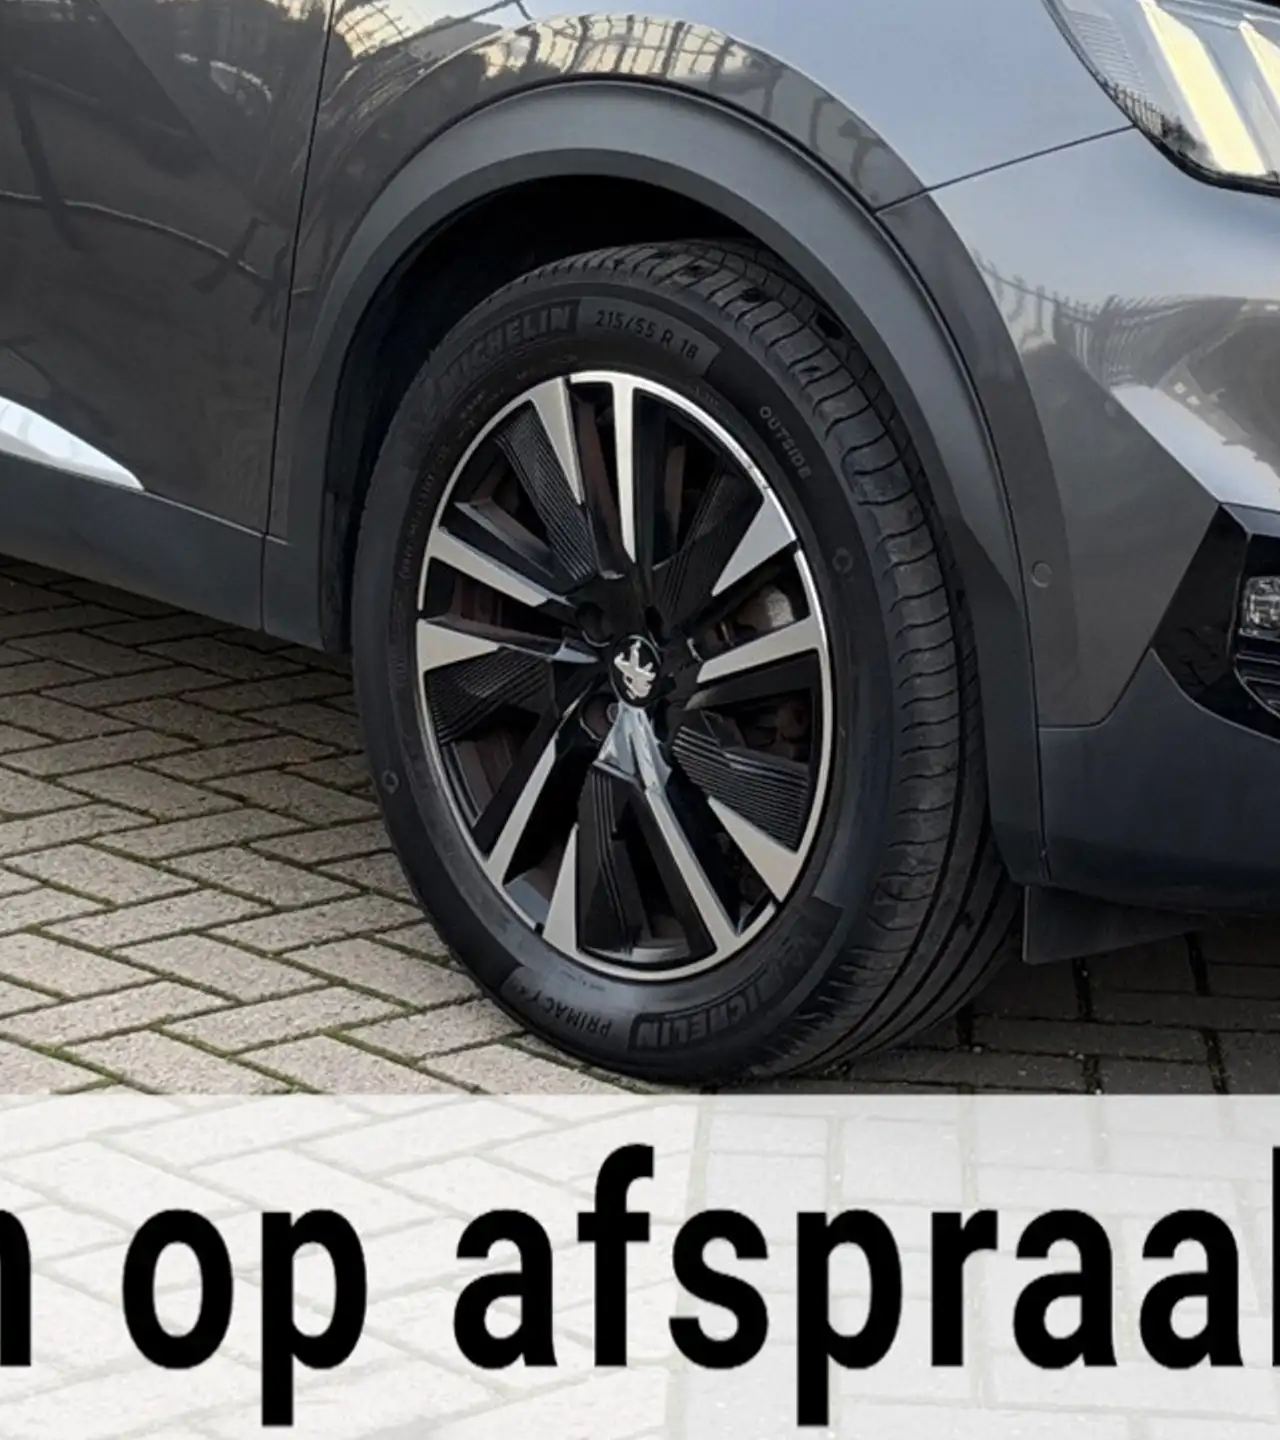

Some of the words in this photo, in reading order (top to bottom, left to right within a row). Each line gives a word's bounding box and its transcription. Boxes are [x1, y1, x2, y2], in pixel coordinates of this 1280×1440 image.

[595, 309, 658, 339] 215/55
[660, 328, 674, 347] R
[680, 339, 700, 360] 18
[759, 405, 812, 479] OUTSIDE
[527, 989, 612, 1040] PRIMACY
